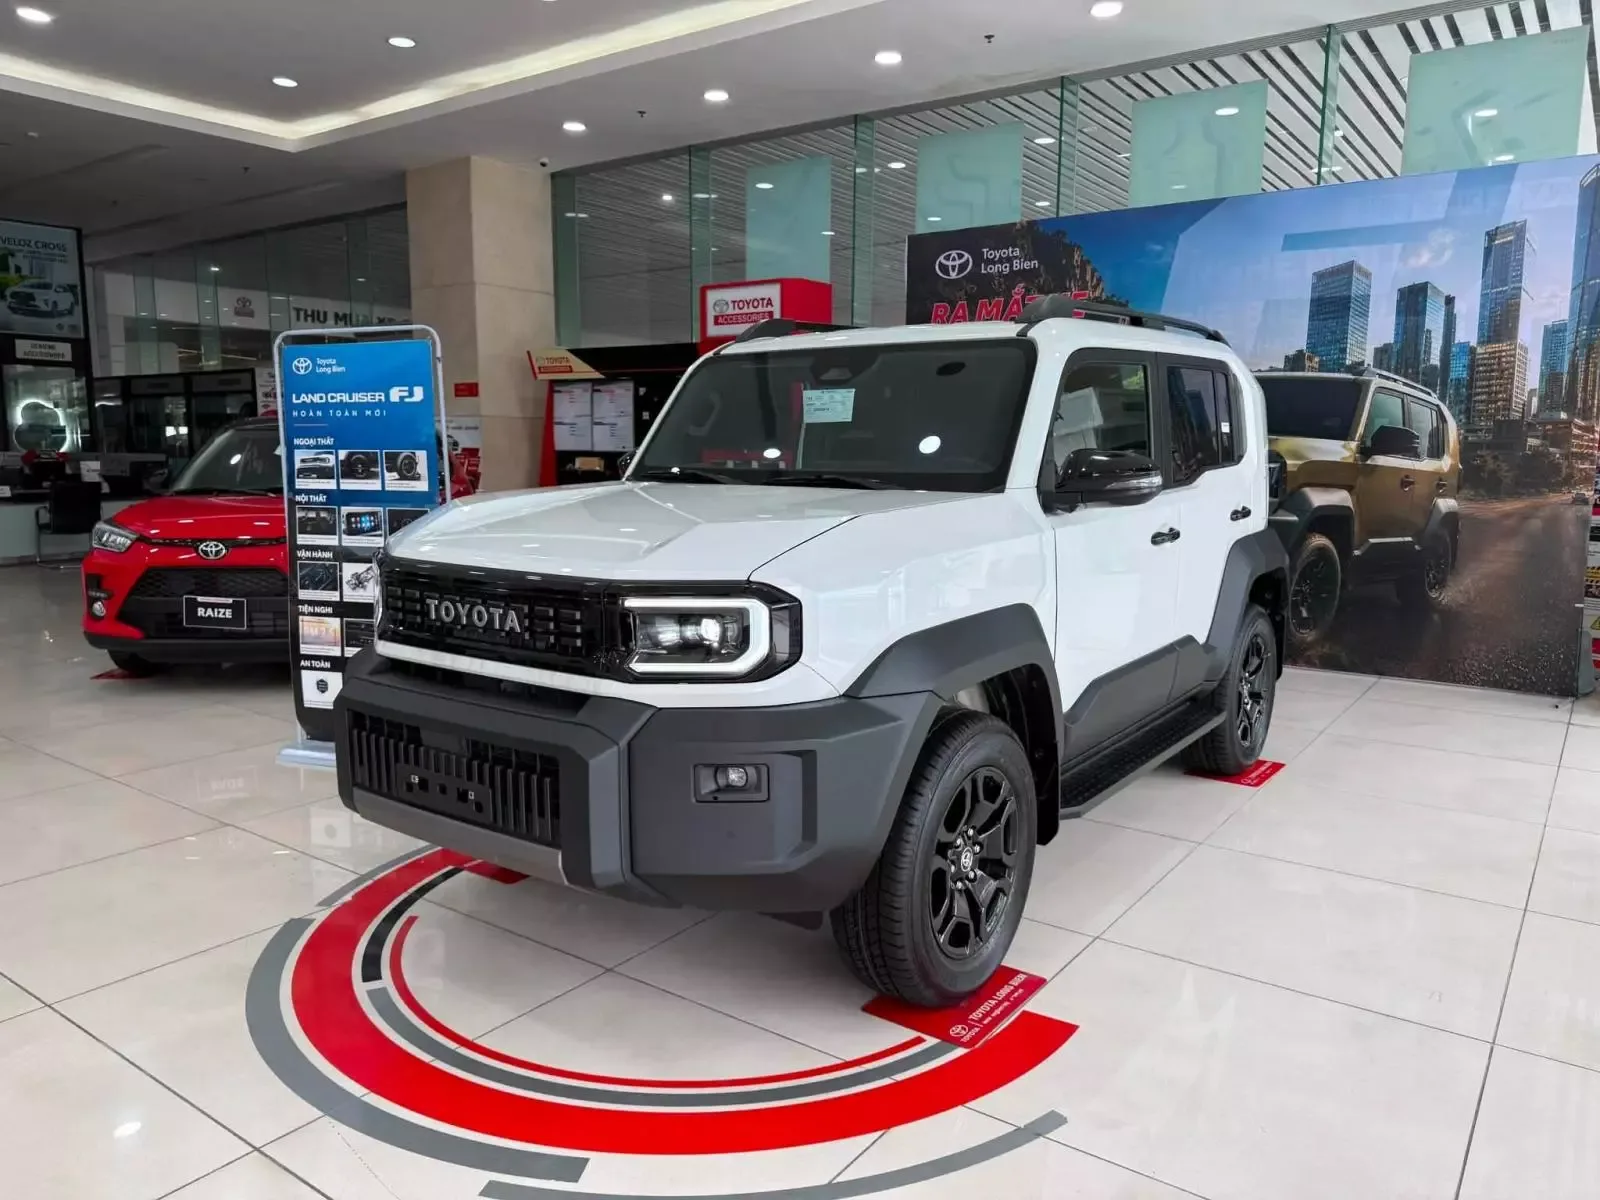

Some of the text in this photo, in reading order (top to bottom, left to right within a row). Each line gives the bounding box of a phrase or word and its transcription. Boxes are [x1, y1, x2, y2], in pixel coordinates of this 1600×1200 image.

[0, 235, 67, 252] VELOZ CROSS
[981, 246, 1020, 261] Toyota
[981, 258, 1039, 275] Long Bien
[731, 297, 774, 311] TOYOTA
[931, 300, 969, 324] RA
[975, 283, 1041, 322] MẮ
[293, 307, 328, 324] THU
[718, 312, 770, 324] ACCESSORIES
[316, 357, 337, 366] Toyota
[315, 366, 331, 374] Long
[292, 386, 424, 404] LAND CRUISER FJ
[292, 409, 323, 417] HOÀN
[329, 409, 358, 417] TOÀN
[196, 607, 233, 619] RAIZE
[314, 605, 333, 614] NGHI
[425, 598, 521, 633] TOYOTA
[300, 659, 331, 668] AN TOÀN
[968, 999, 999, 1021] TOYOTA
[992, 984, 1015, 1000] LONG
